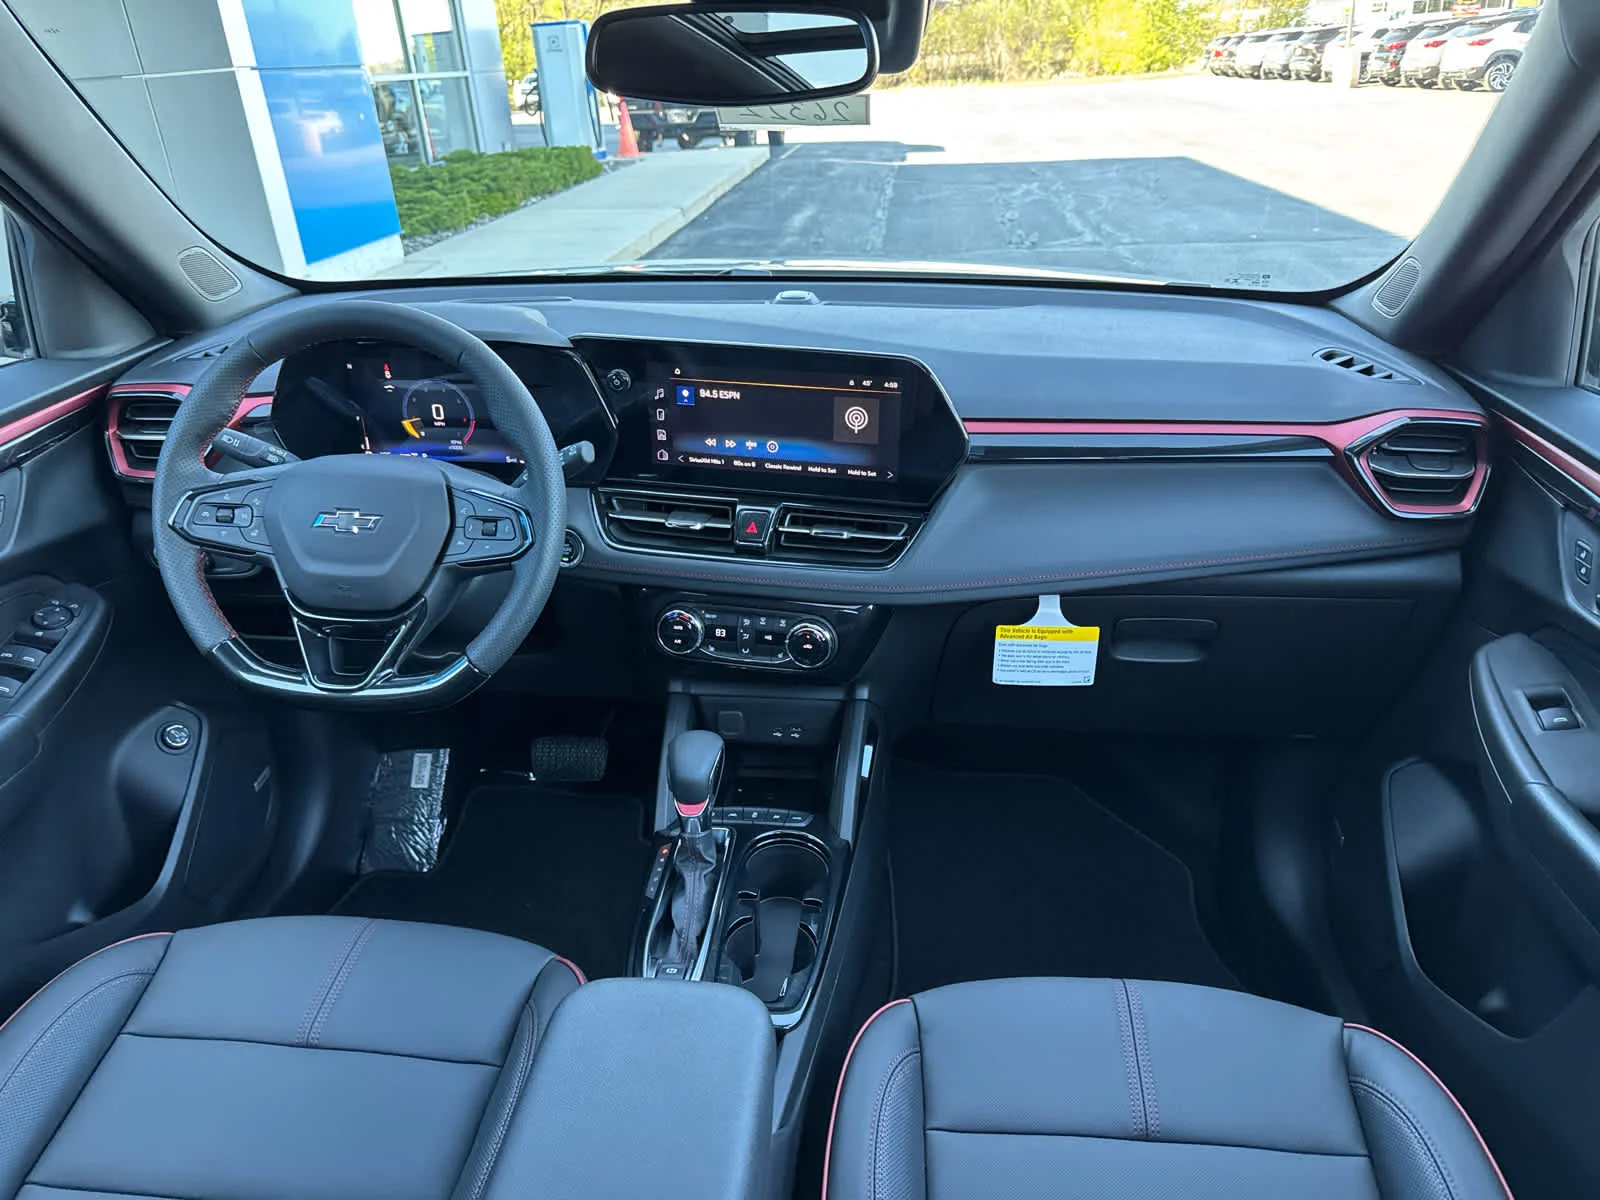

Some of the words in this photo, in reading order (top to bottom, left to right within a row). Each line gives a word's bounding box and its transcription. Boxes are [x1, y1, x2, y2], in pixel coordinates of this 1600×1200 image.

[699, 388, 718, 399] 94.5
[719, 390, 741, 400] ESPN
[431, 403, 445, 420] 0
